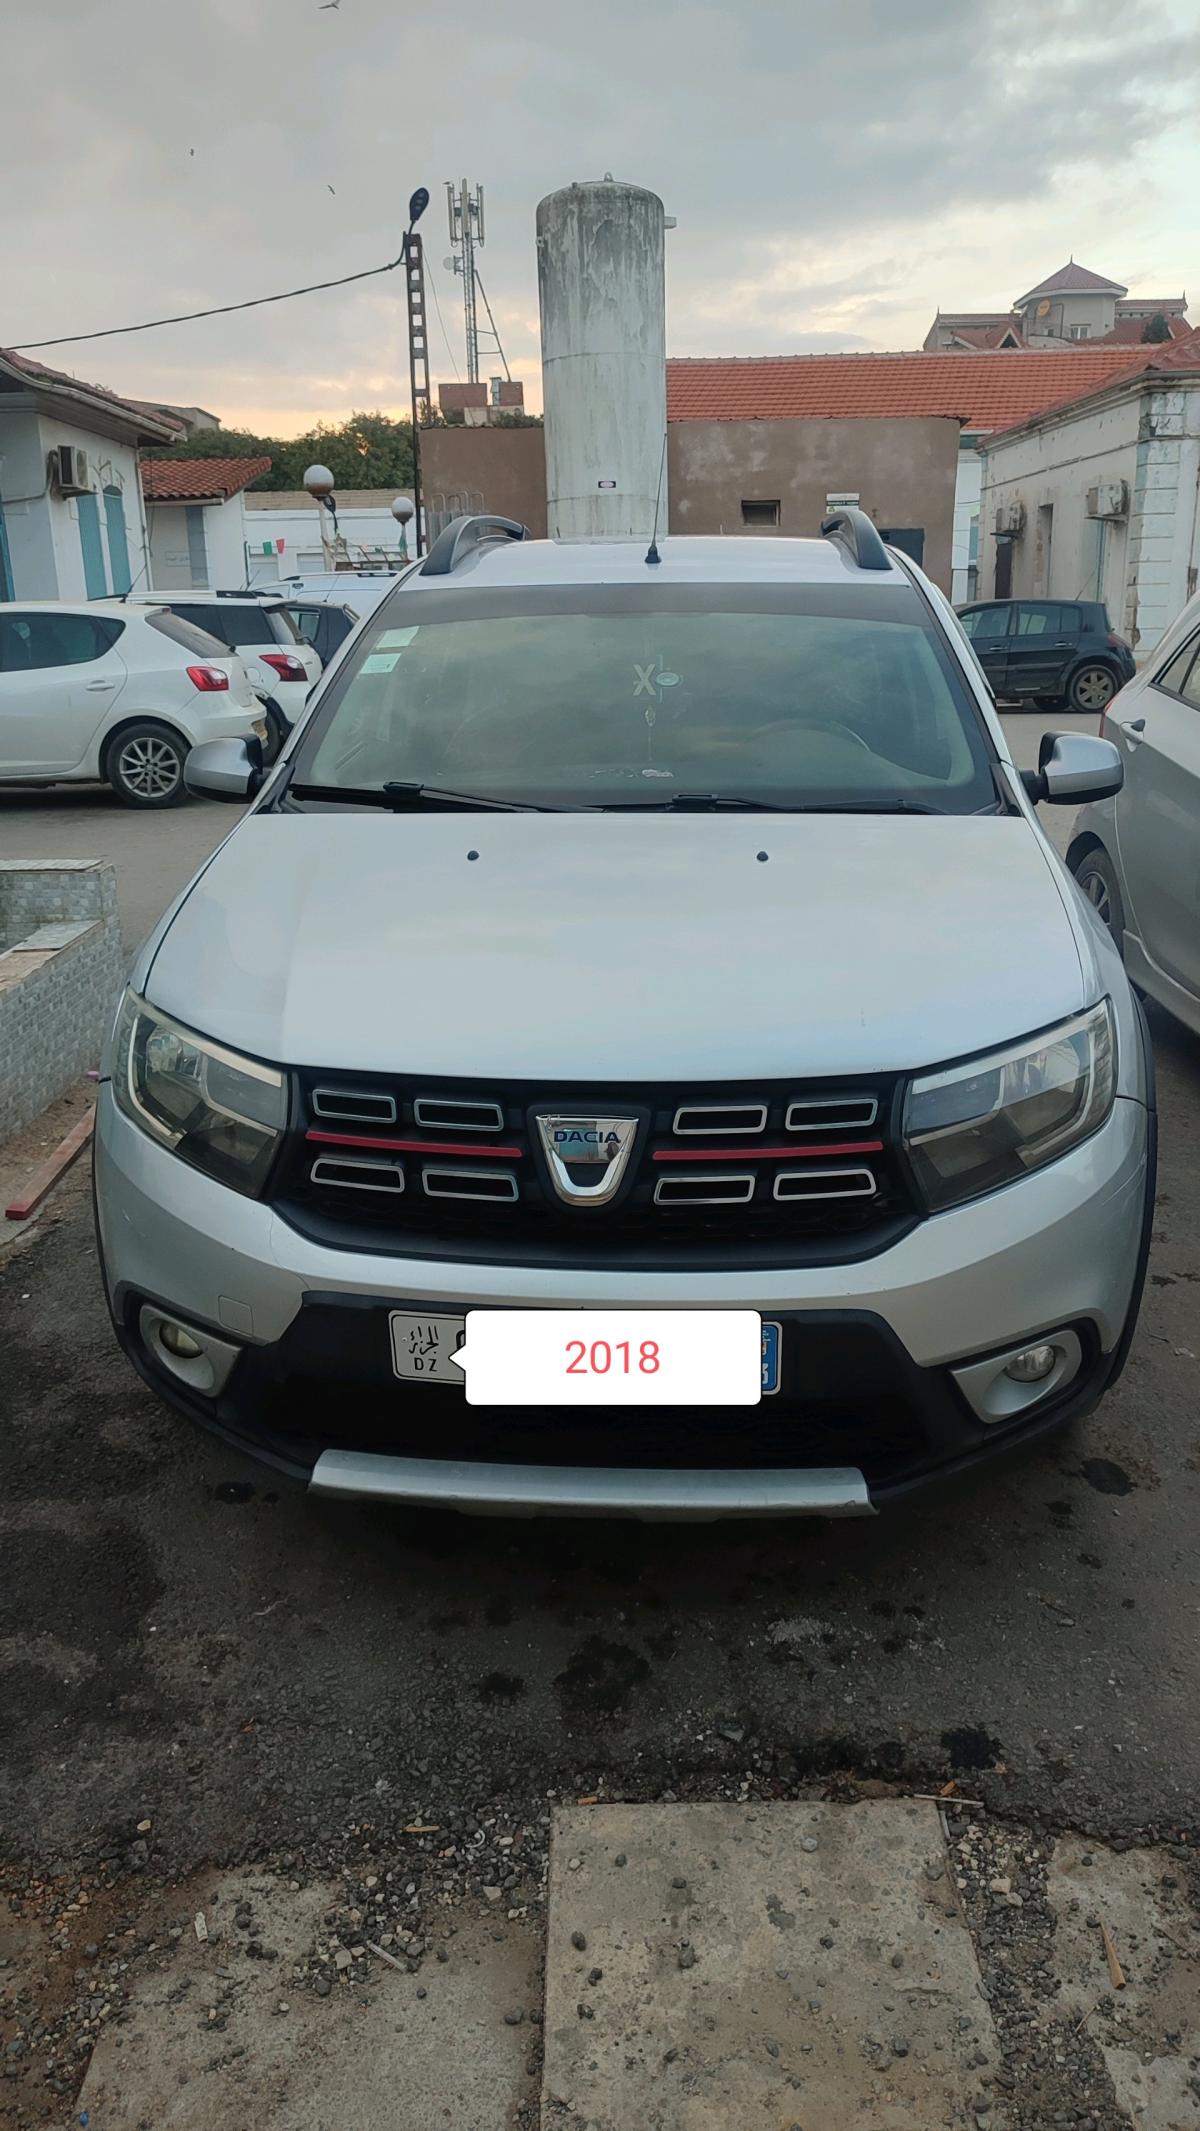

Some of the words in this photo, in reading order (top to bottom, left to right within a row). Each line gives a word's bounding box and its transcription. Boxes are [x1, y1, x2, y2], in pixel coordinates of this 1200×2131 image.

[554, 1131, 621, 1143] DACIA
[408, 1325, 439, 1355] الجزائر
[414, 1357, 438, 1372] DZ
